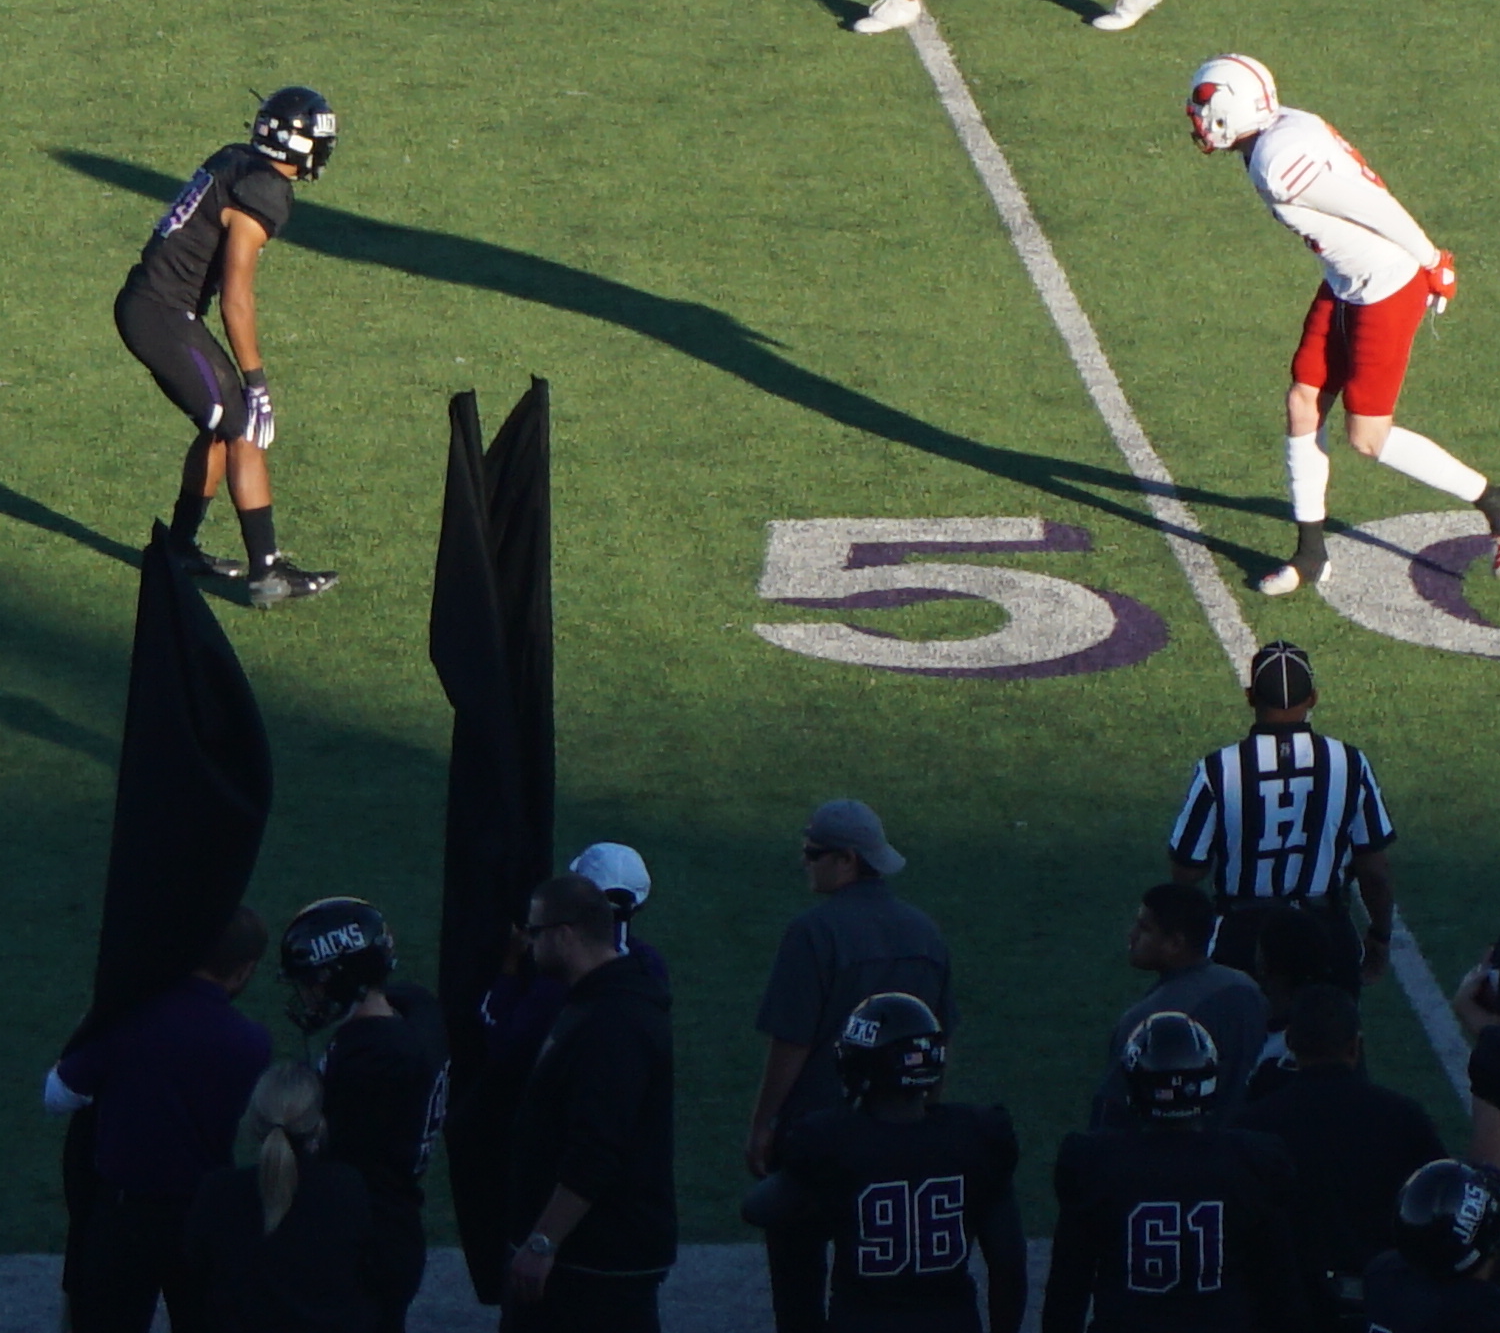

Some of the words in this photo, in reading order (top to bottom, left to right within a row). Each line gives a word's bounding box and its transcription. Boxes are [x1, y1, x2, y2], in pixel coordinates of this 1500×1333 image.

[1254, 775, 1316, 852] H
[309, 922, 367, 966] JACKS
[857, 1174, 968, 1276] 96
[1127, 1200, 1225, 1294] 61
[1452, 1182, 1487, 1245] JACKS
